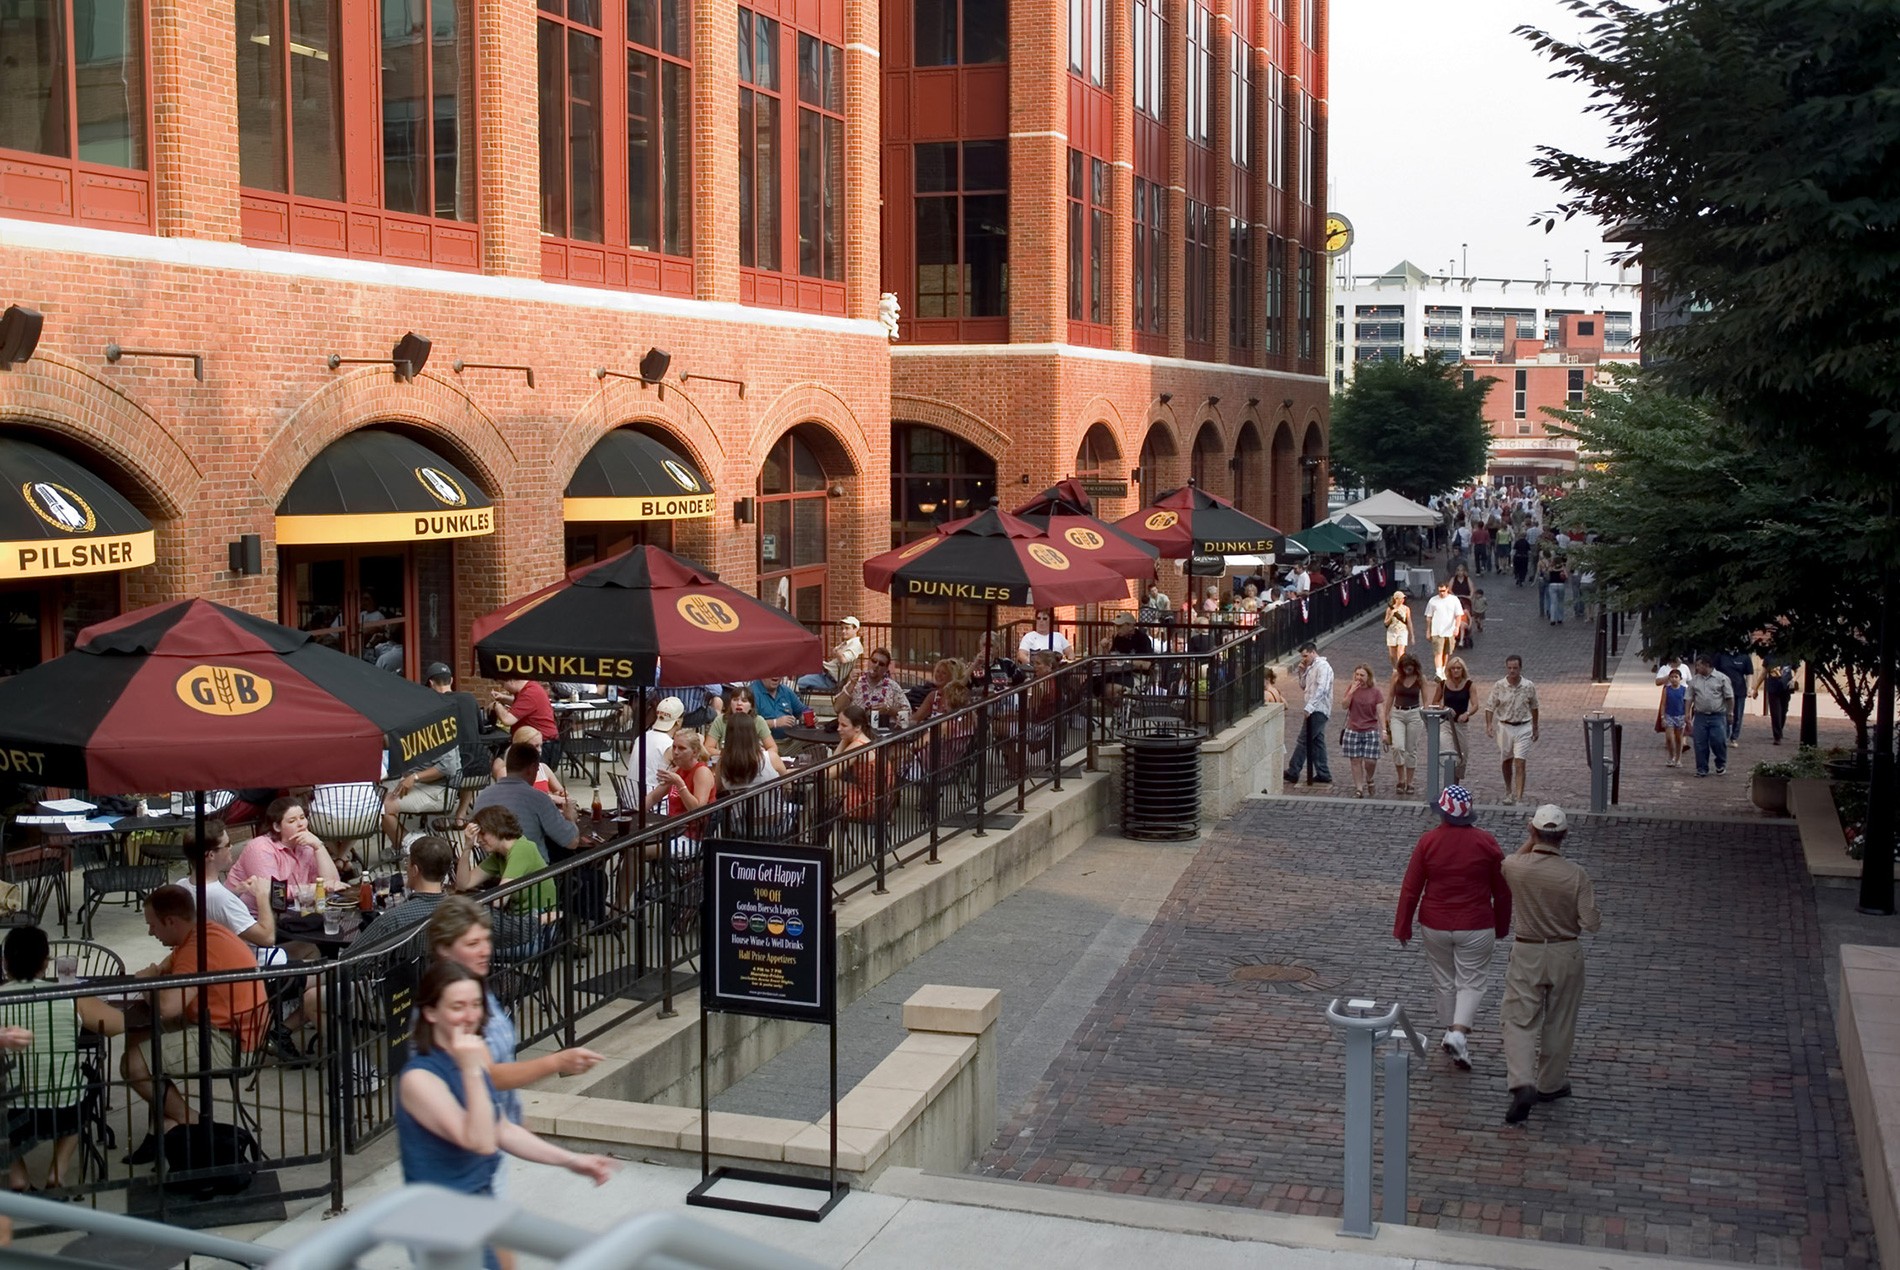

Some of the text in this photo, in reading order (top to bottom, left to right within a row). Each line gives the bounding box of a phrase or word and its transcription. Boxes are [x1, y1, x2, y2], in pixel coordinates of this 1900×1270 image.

[1493, 440, 1525, 449] ESIGN
[641, 499, 703, 516] BLONDE
[414, 513, 490, 536] DUNKLES
[1070, 532, 1099, 545] GB
[1204, 540, 1274, 553] DUNKLES
[18, 541, 134, 571] PILSNER
[908, 580, 1011, 601] DUNKLES
[684, 602, 733, 628] GB
[495, 655, 635, 678] DUNKLES
[190, 675, 260, 706] GB
[400, 716, 458, 762] DUNKLES
[730, 861, 806, 888] C'mon Get Happy!
[769, 889, 781, 903] Off
[736, 900, 800, 917] Gordon Biersch Lagers
[731, 933, 804, 951] House Wine & Well Drinks
[738, 949, 797, 965] Half Price Appetizers
